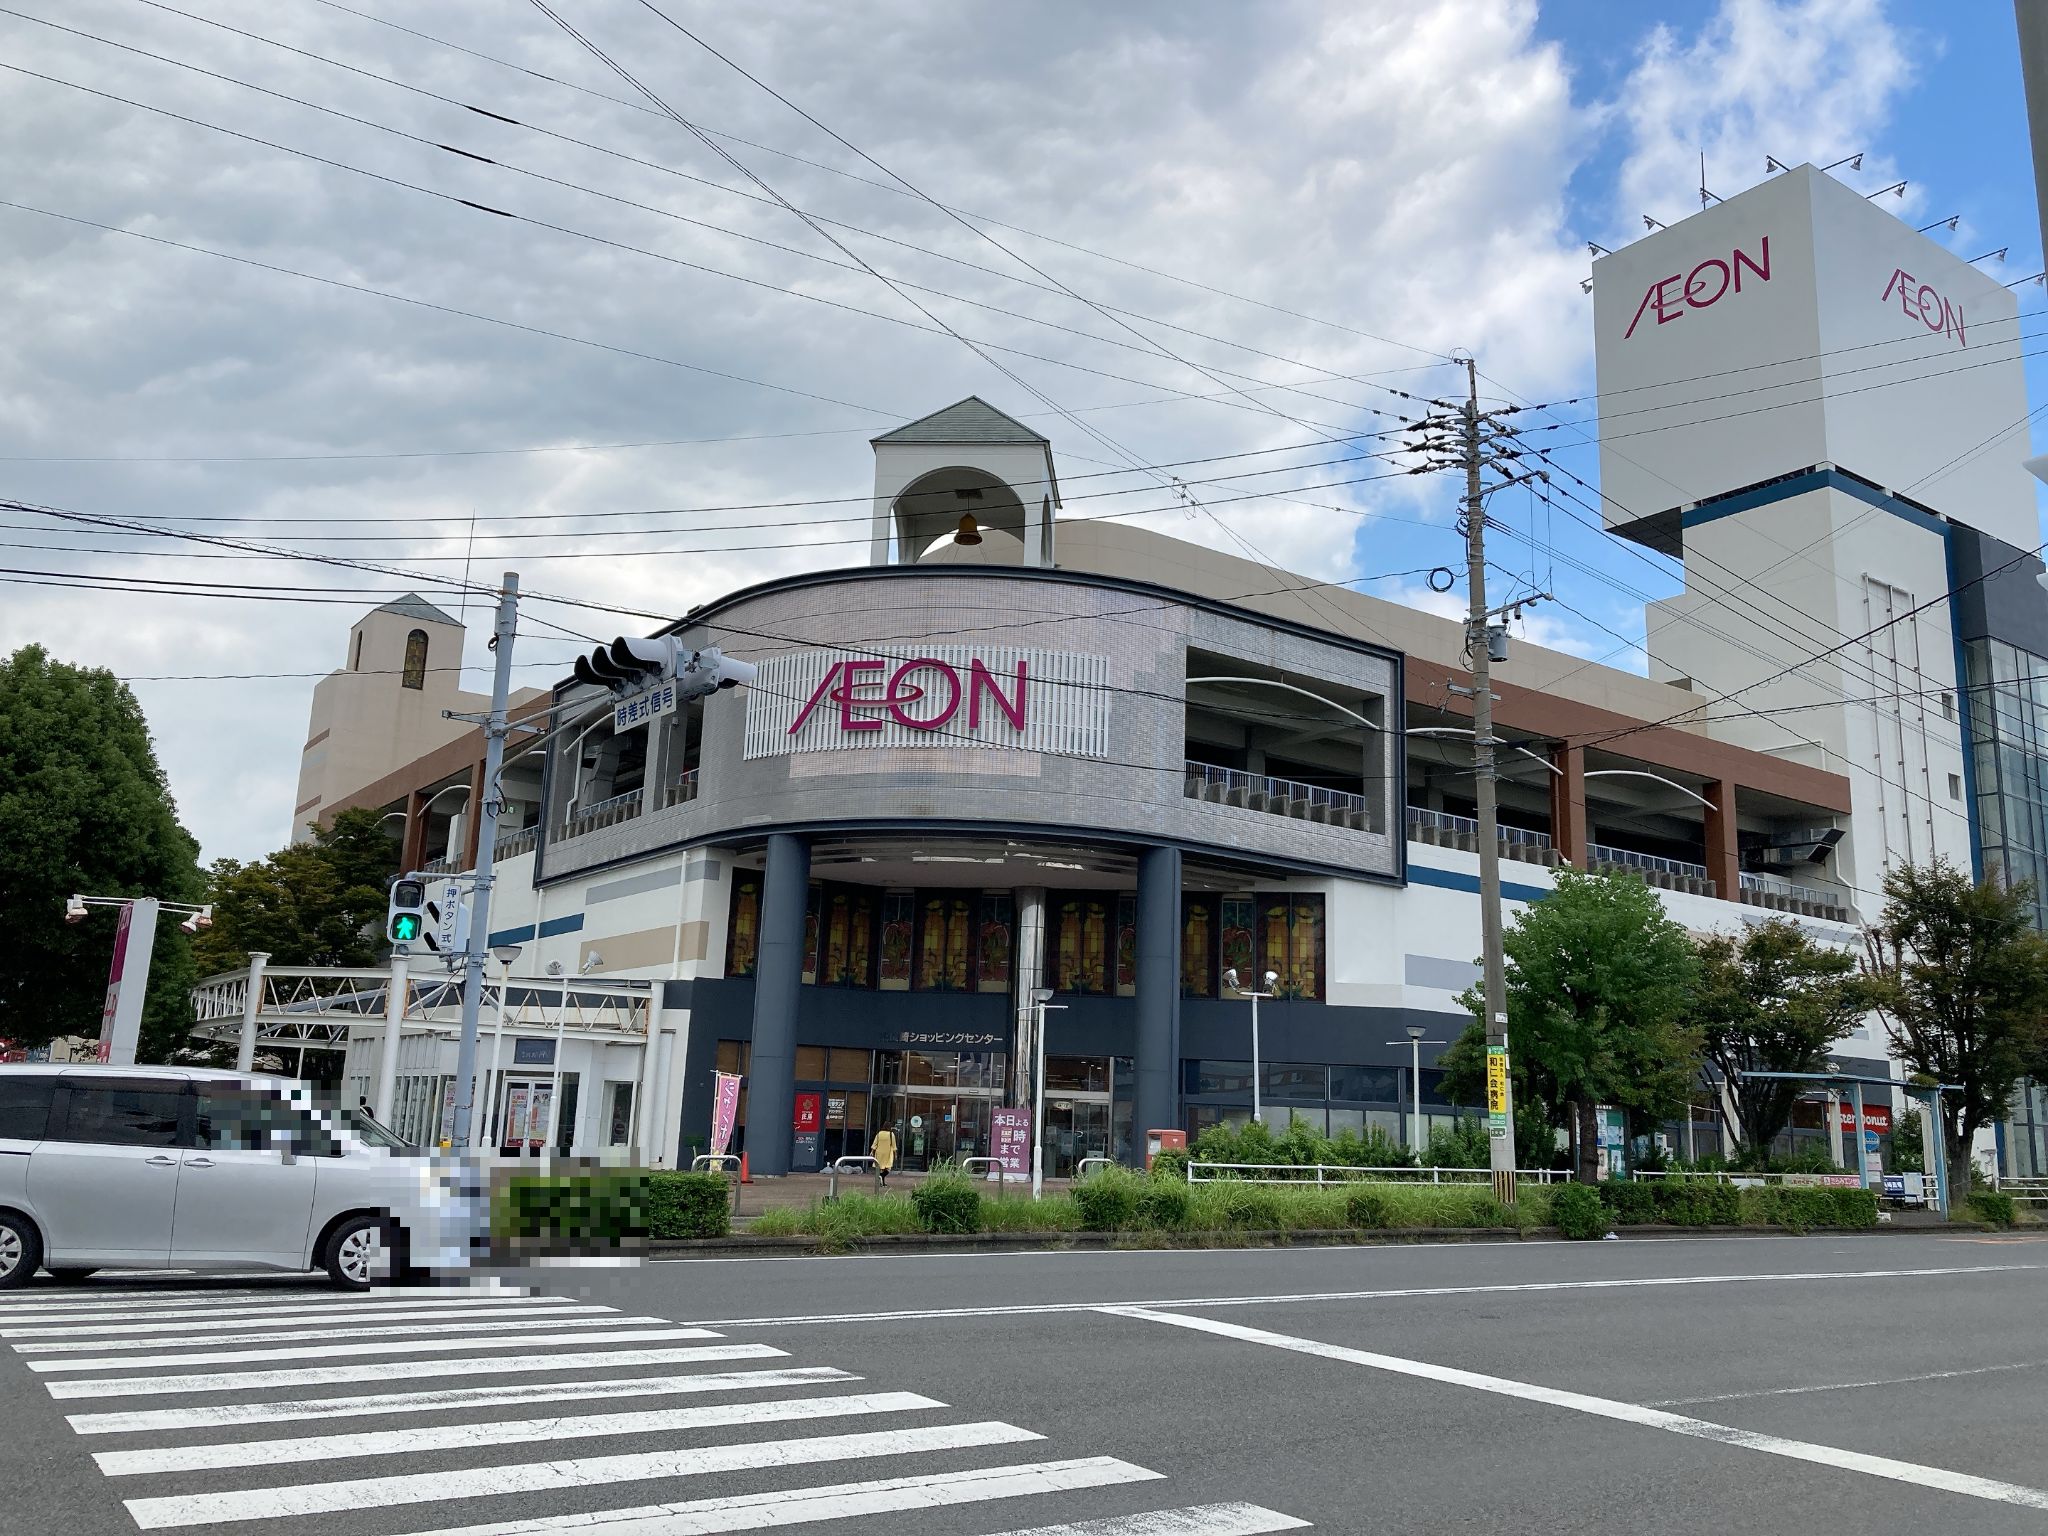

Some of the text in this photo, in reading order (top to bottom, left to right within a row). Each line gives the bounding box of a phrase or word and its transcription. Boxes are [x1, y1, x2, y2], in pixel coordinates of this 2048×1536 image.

[617, 686, 674, 727] 時差式信号
[441, 888, 457, 944] 押ボタン式
[882, 1031, 1003, 1044] 崎ショッピングセンター
[1489, 1056, 1499, 1111] 和仁会病院
[994, 1113, 1029, 1127] 本日よる
[1013, 1129, 1027, 1144] 時
[1000, 1143, 1021, 1155] まで
[1000, 1156, 1020, 1169] 営業
